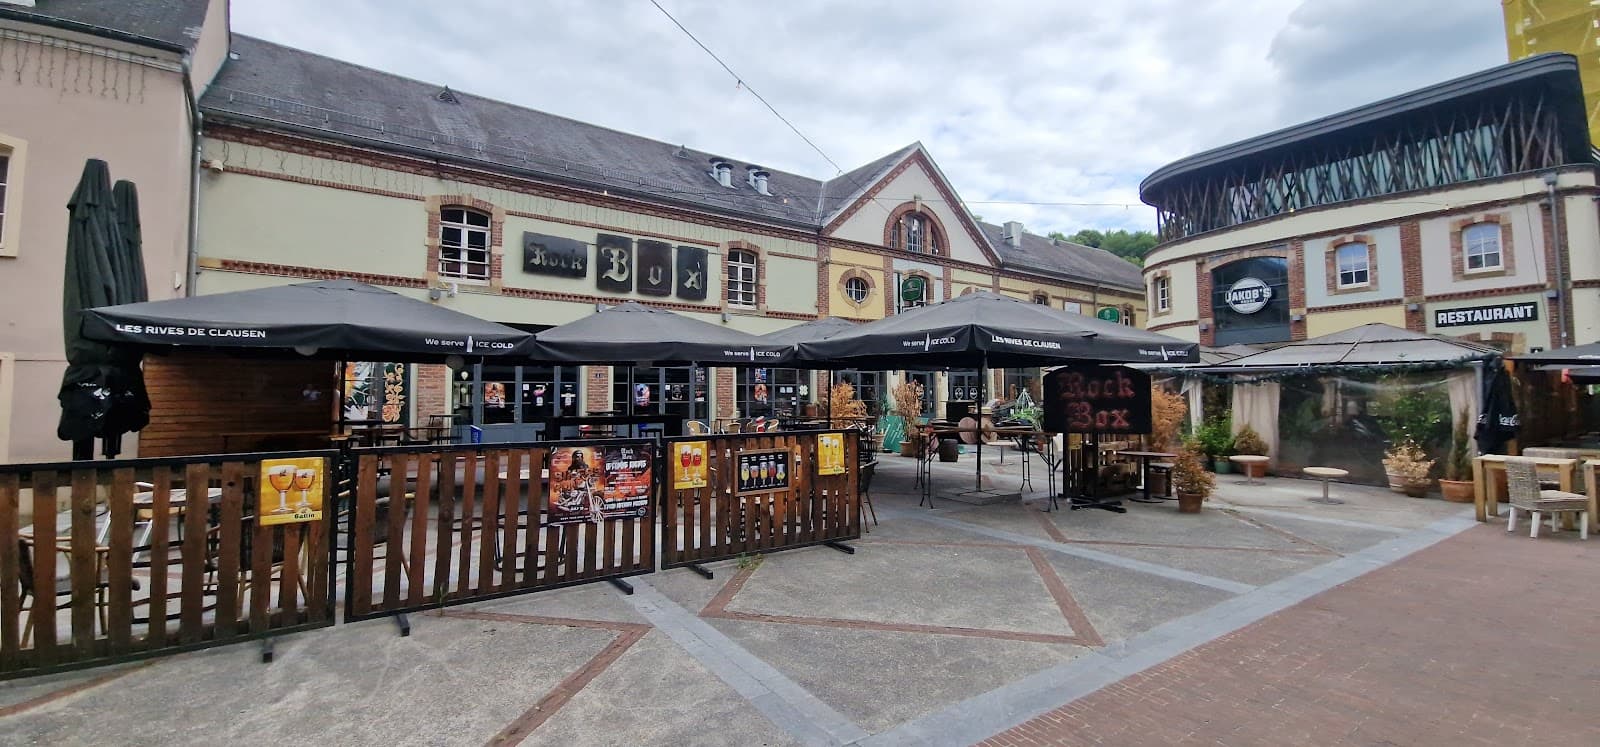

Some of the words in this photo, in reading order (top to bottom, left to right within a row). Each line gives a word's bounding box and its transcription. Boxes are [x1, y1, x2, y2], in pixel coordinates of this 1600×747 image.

[529, 243, 583, 270] Rock
[601, 246, 702, 290] Box
[1225, 287, 1272, 303] JAKOB'S
[1437, 305, 1534, 324] RESTAURANT
[115, 324, 142, 333] LES
[145, 325, 185, 335] RIVES
[188, 328, 206, 336] DE
[208, 328, 266, 338] CLAUSEN
[424, 338, 439, 346] We
[490, 341, 514, 349] COLD
[940, 336, 956, 344] COLD
[991, 334, 1005, 344] LES
[1023, 339, 1033, 347] DE
[1033, 340, 1062, 349] CLAUSEN
[1059, 371, 1135, 398] Rock
[1068, 401, 1130, 428] Box
